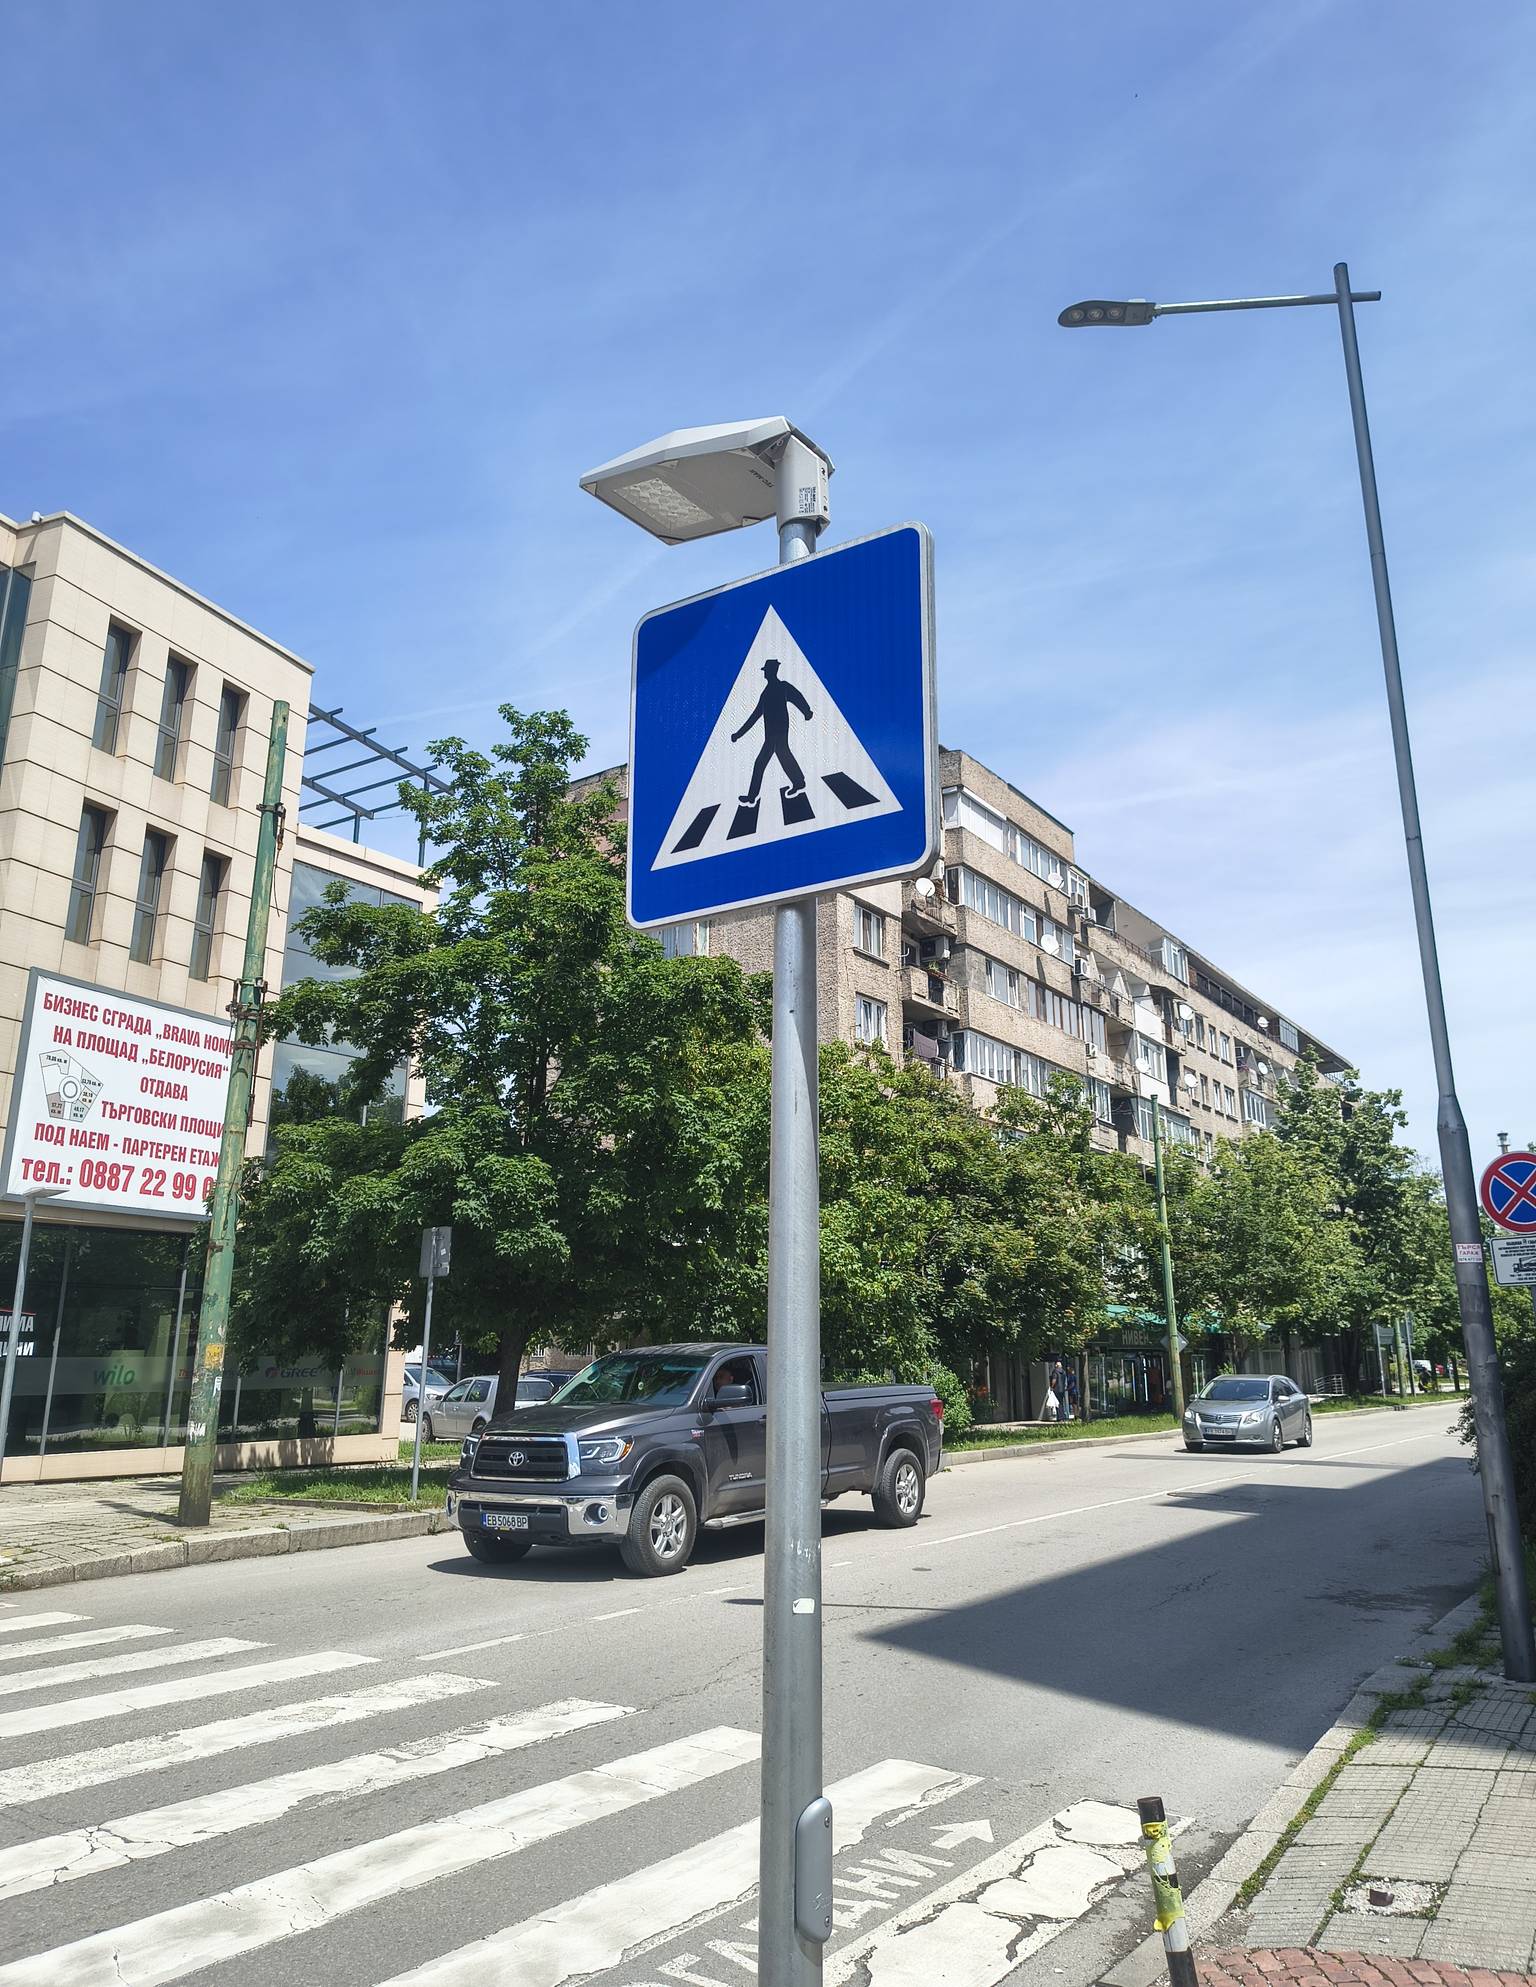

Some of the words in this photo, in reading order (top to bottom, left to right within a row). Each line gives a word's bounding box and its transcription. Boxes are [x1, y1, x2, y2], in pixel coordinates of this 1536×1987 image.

[43, 992, 99, 1022] БИЗНЕС
[102, 1008, 152, 1036] СГРАДА
[53, 1025, 72, 1046] НА
[76, 1031, 139, 1063] ПЛОЩАД
[139, 1077, 188, 1101] ОТДАВА
[101, 1100, 177, 1131] ТЪРГОВСКИ
[34, 1122, 66, 1147] ПОД
[69, 1128, 110, 1151] НАЕМ
[122, 1137, 187, 1163] ПАРТЕРЕН
[189, 1147, 219, 1168] ЕТАЖ
[79, 1158, 135, 1193] 0887
[139, 1167, 167, 1197] 22
[172, 1171, 198, 1201] 99
[94, 1364, 136, 1386] wilo
